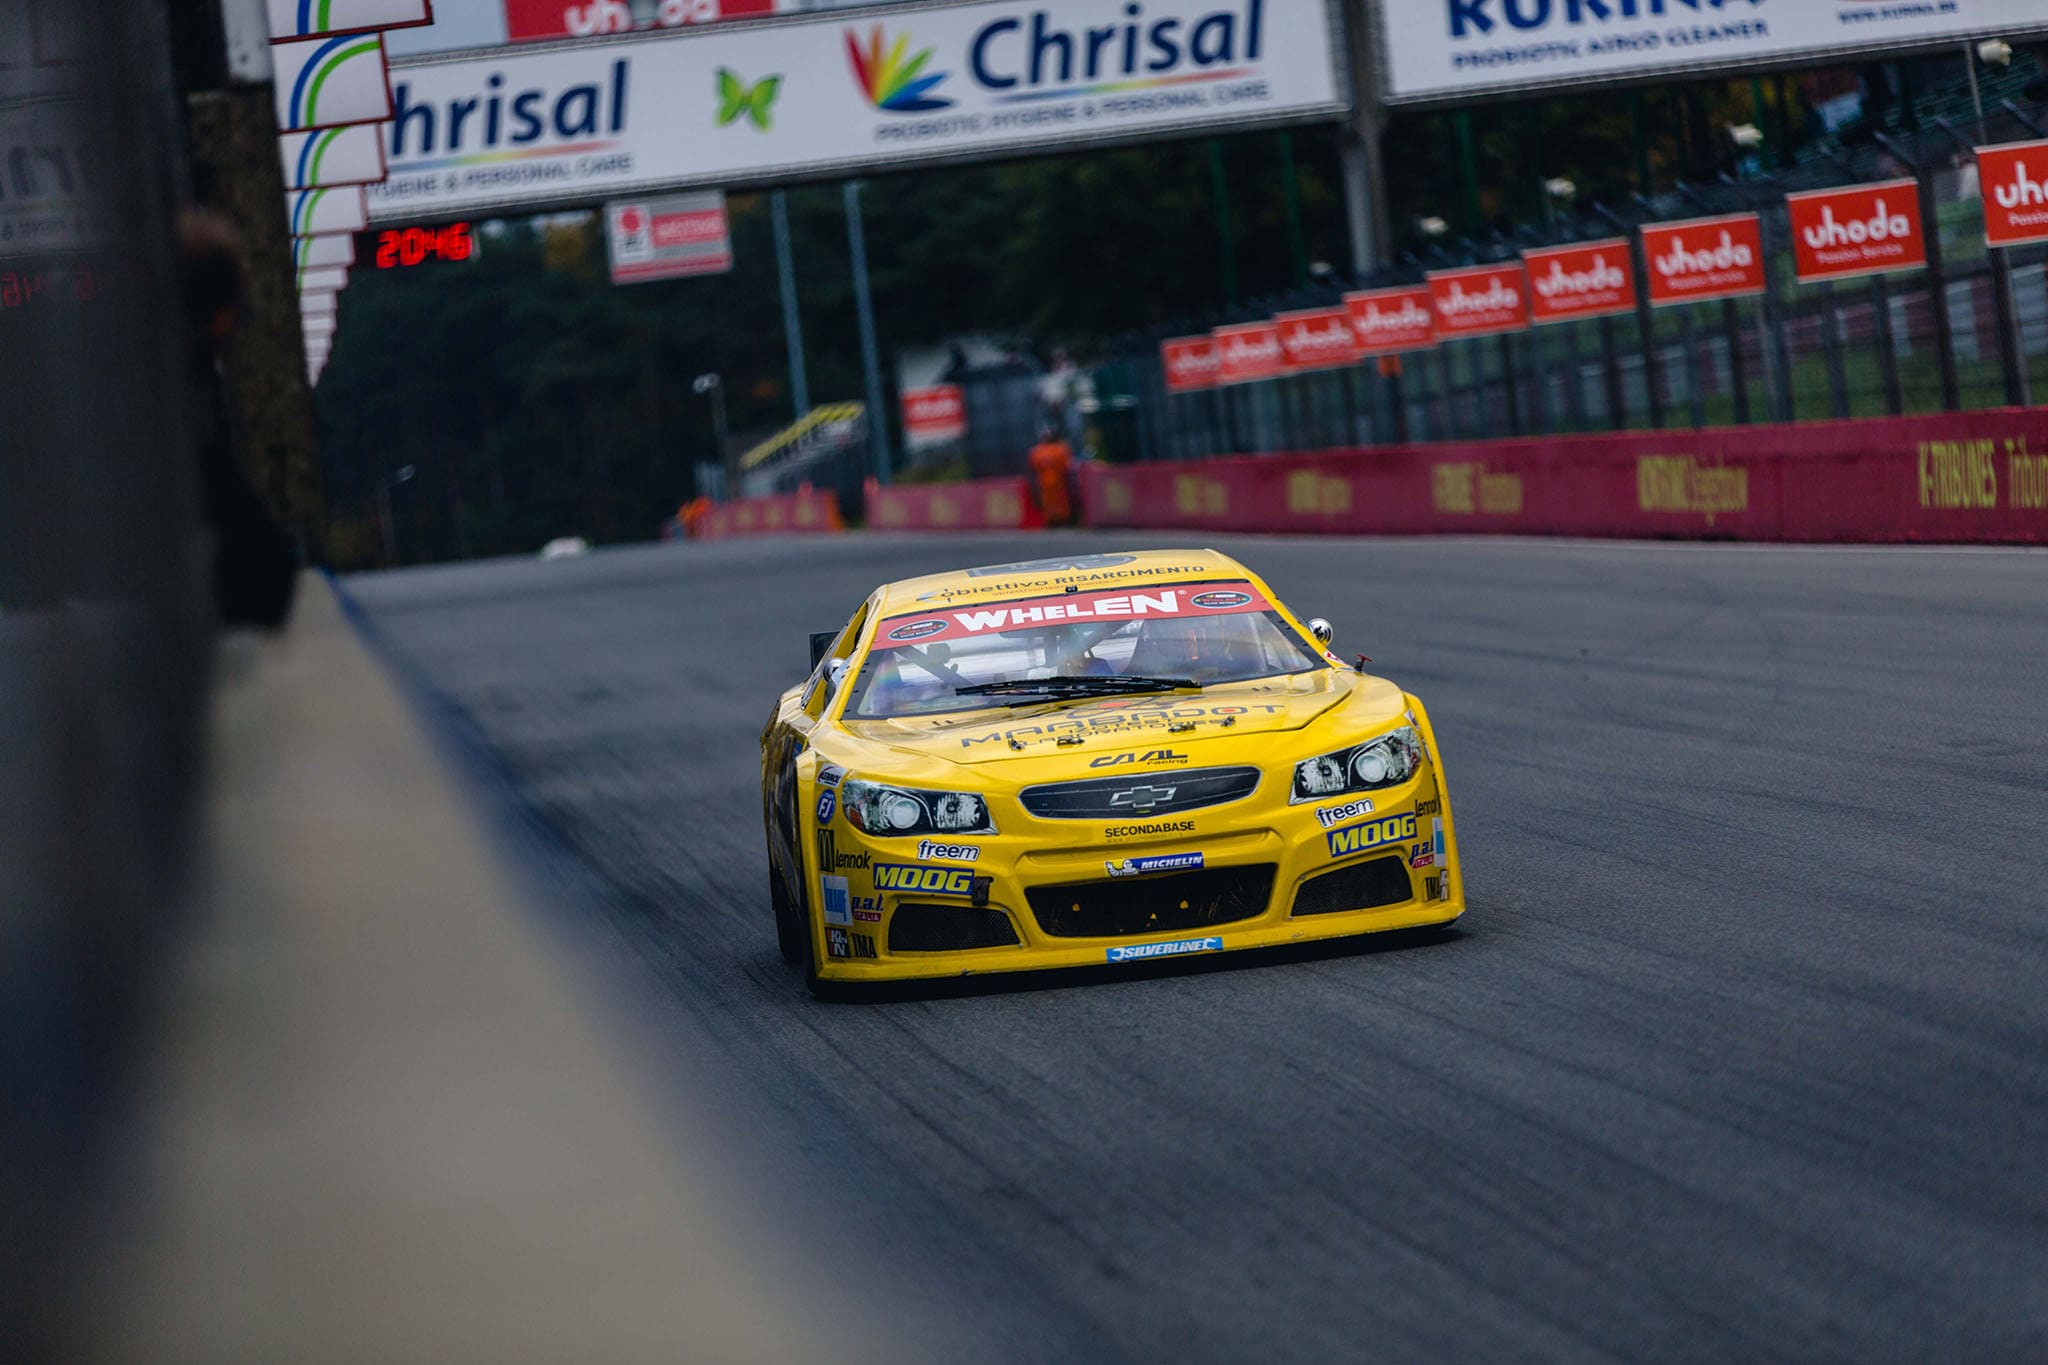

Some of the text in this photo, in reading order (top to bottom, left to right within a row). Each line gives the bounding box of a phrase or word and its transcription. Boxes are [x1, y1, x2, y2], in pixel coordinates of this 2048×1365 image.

[969, 0, 1262, 90] Chrisal
[1665, 18, 1769, 46] CLEANER
[393, 59, 629, 155] hrisal
[1994, 160, 2048, 209] uh
[1803, 197, 1911, 249] uhoda
[1655, 229, 1752, 277] uhoda
[941, 565, 1205, 600] obiettivo RISARCIMENTO
[953, 591, 1179, 631] WHELEN
[1104, 821, 1196, 838] SECONDABASE
[1317, 799, 1374, 825] freem
[919, 840, 980, 861] freem
[1331, 814, 1416, 855] MOOG
[835, 848, 872, 869] lennok
[1141, 856, 1202, 870] MICHELIN
[874, 866, 973, 892] MOOG
